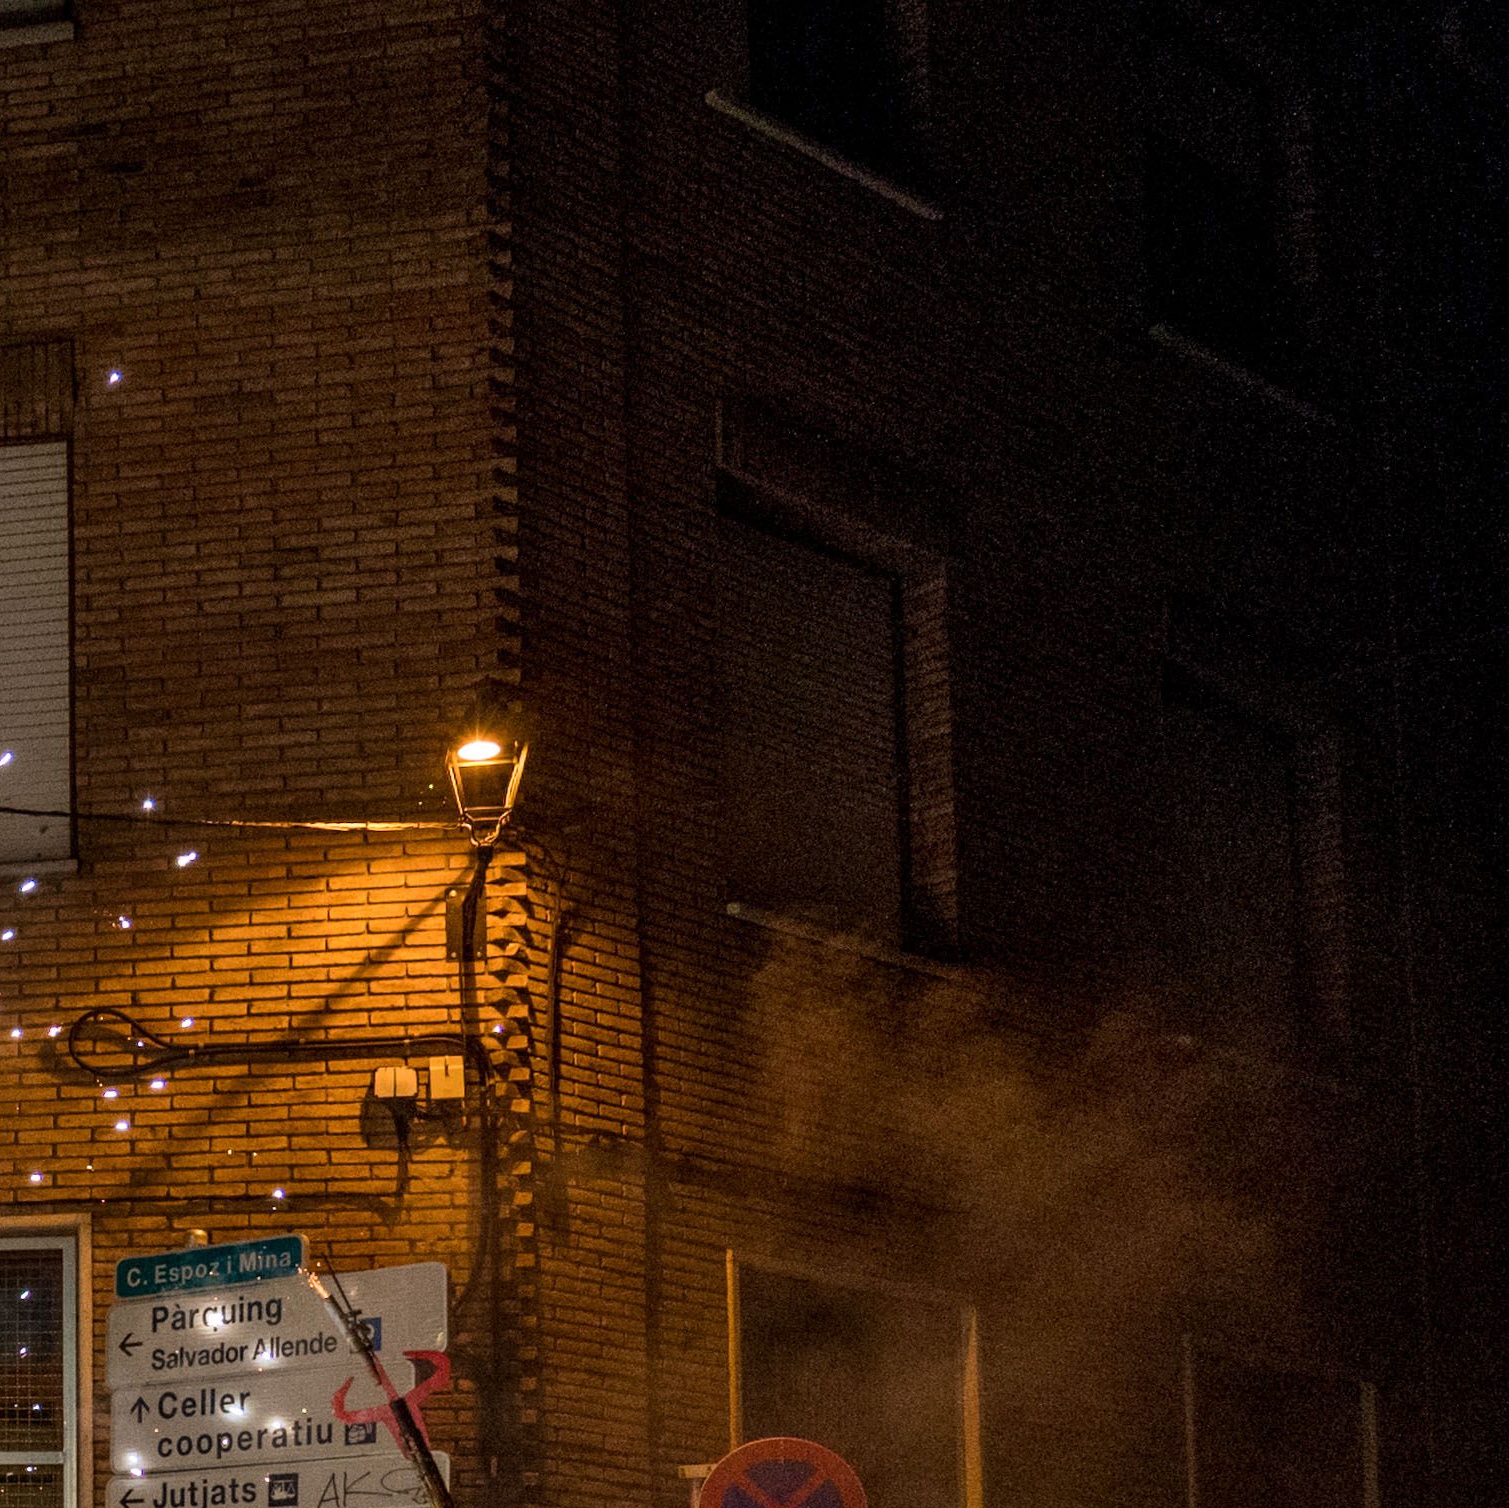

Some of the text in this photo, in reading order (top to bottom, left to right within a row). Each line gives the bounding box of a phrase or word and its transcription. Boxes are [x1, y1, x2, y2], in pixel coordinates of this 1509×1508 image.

[127, 1248, 292, 1288] C. Espoz i Mina
[151, 1296, 283, 1333] Pàrquing
[151, 1332, 337, 1370] Salvador Allende
[158, 1390, 251, 1417] Celler
[158, 1422, 333, 1462] cooperatiu
